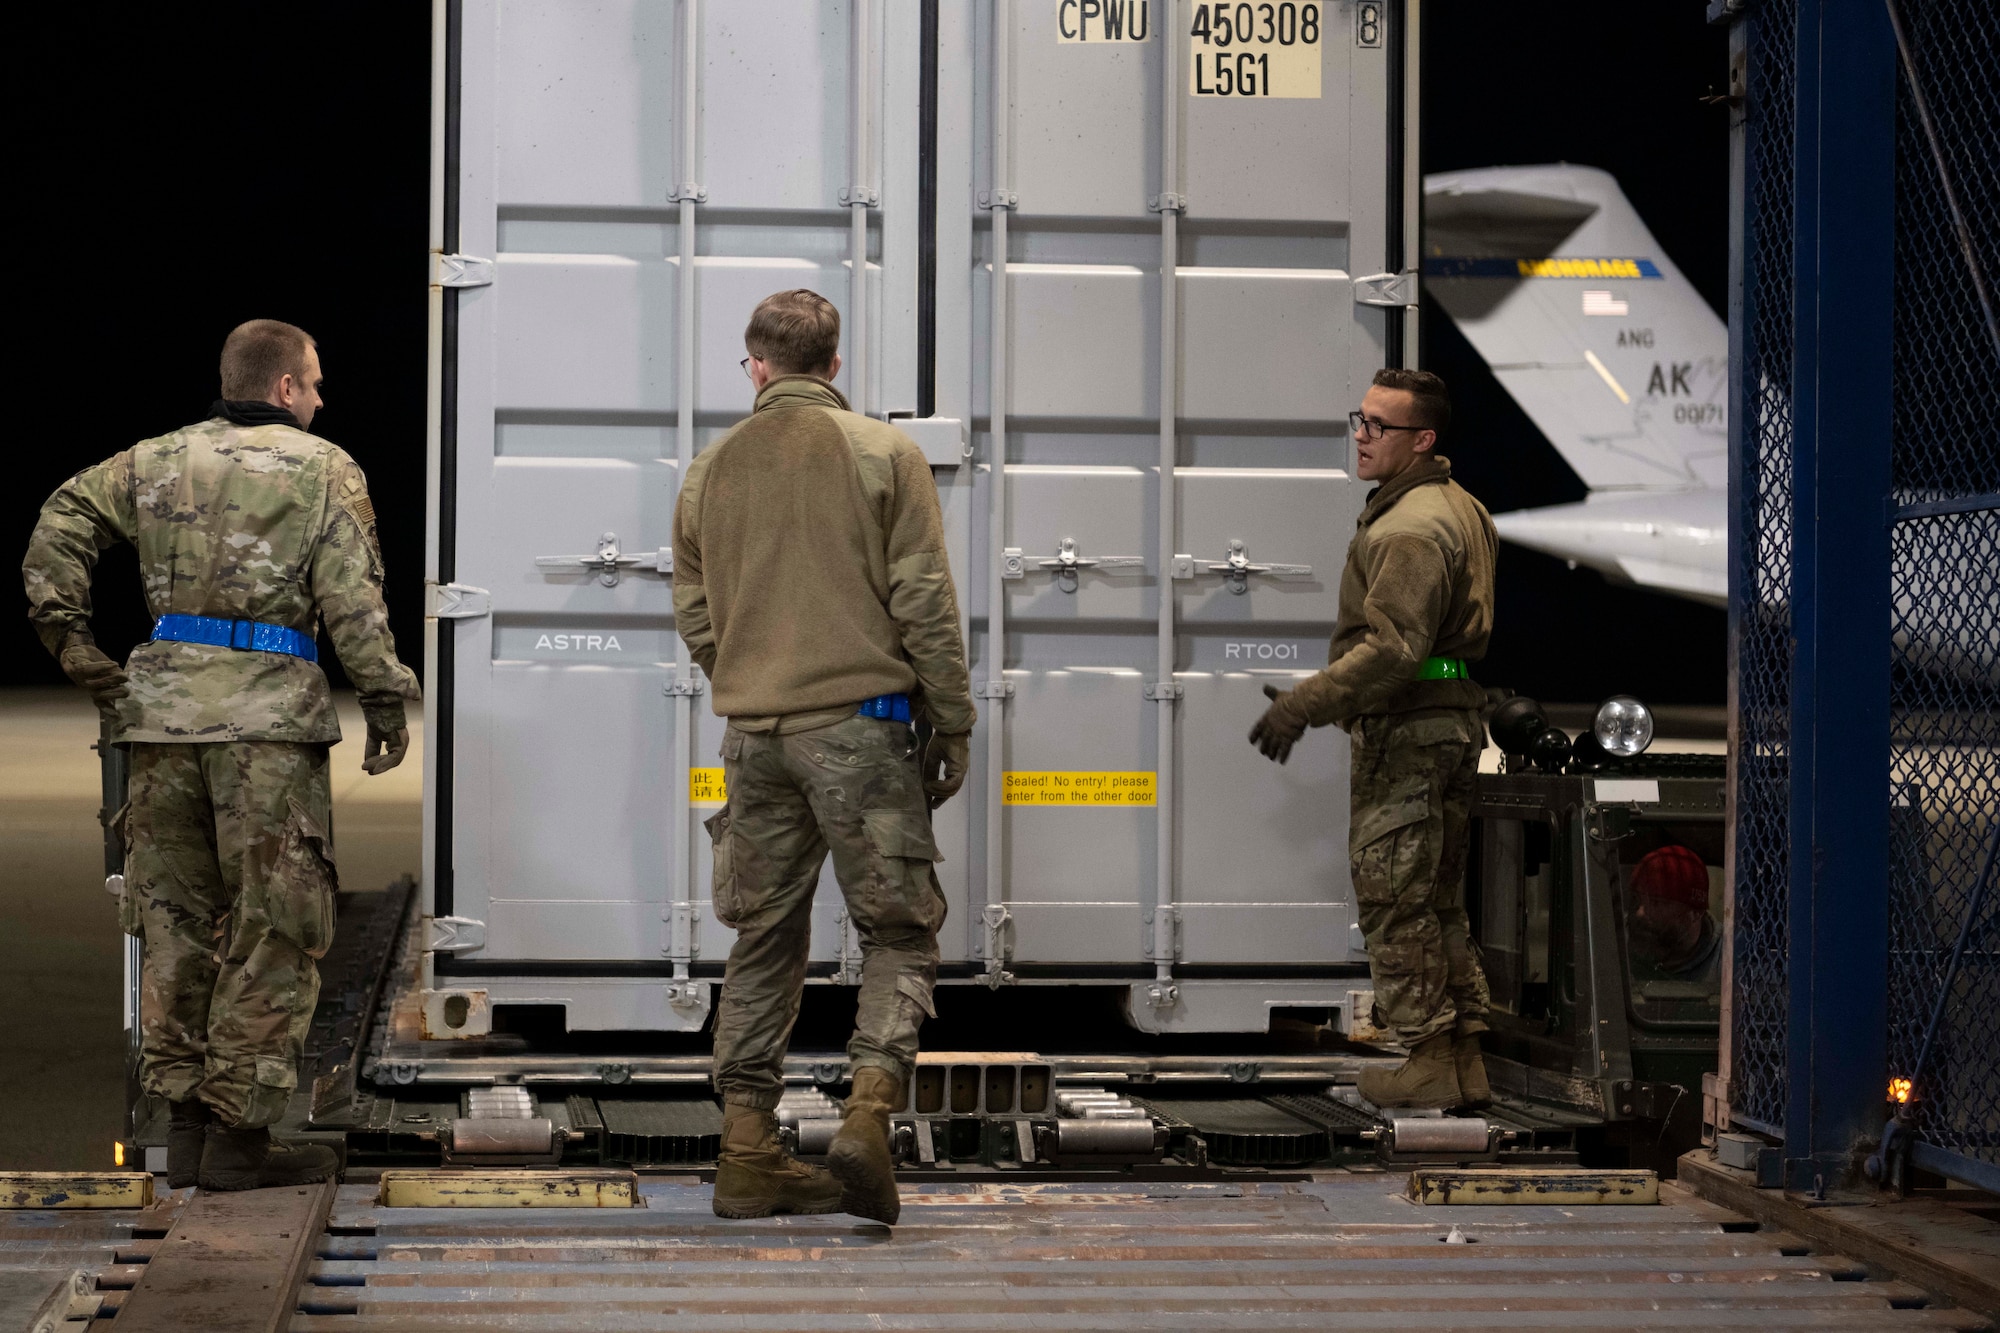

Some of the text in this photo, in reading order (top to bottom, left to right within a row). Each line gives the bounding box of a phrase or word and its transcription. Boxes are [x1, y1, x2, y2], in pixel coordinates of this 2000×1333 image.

[1058, 0, 1379, 47] CPWU 450308 8
[1195, 52, 1270, 96] L5G1
[1617, 327, 1655, 349] ANG
[1646, 360, 1692, 397] AK
[534, 633, 622, 651] ASTRA
[693, 772, 726, 784] 此
[1006, 775, 1149, 789] Sealed! No entry! please
[1006, 791, 1153, 801] enter from the other door
